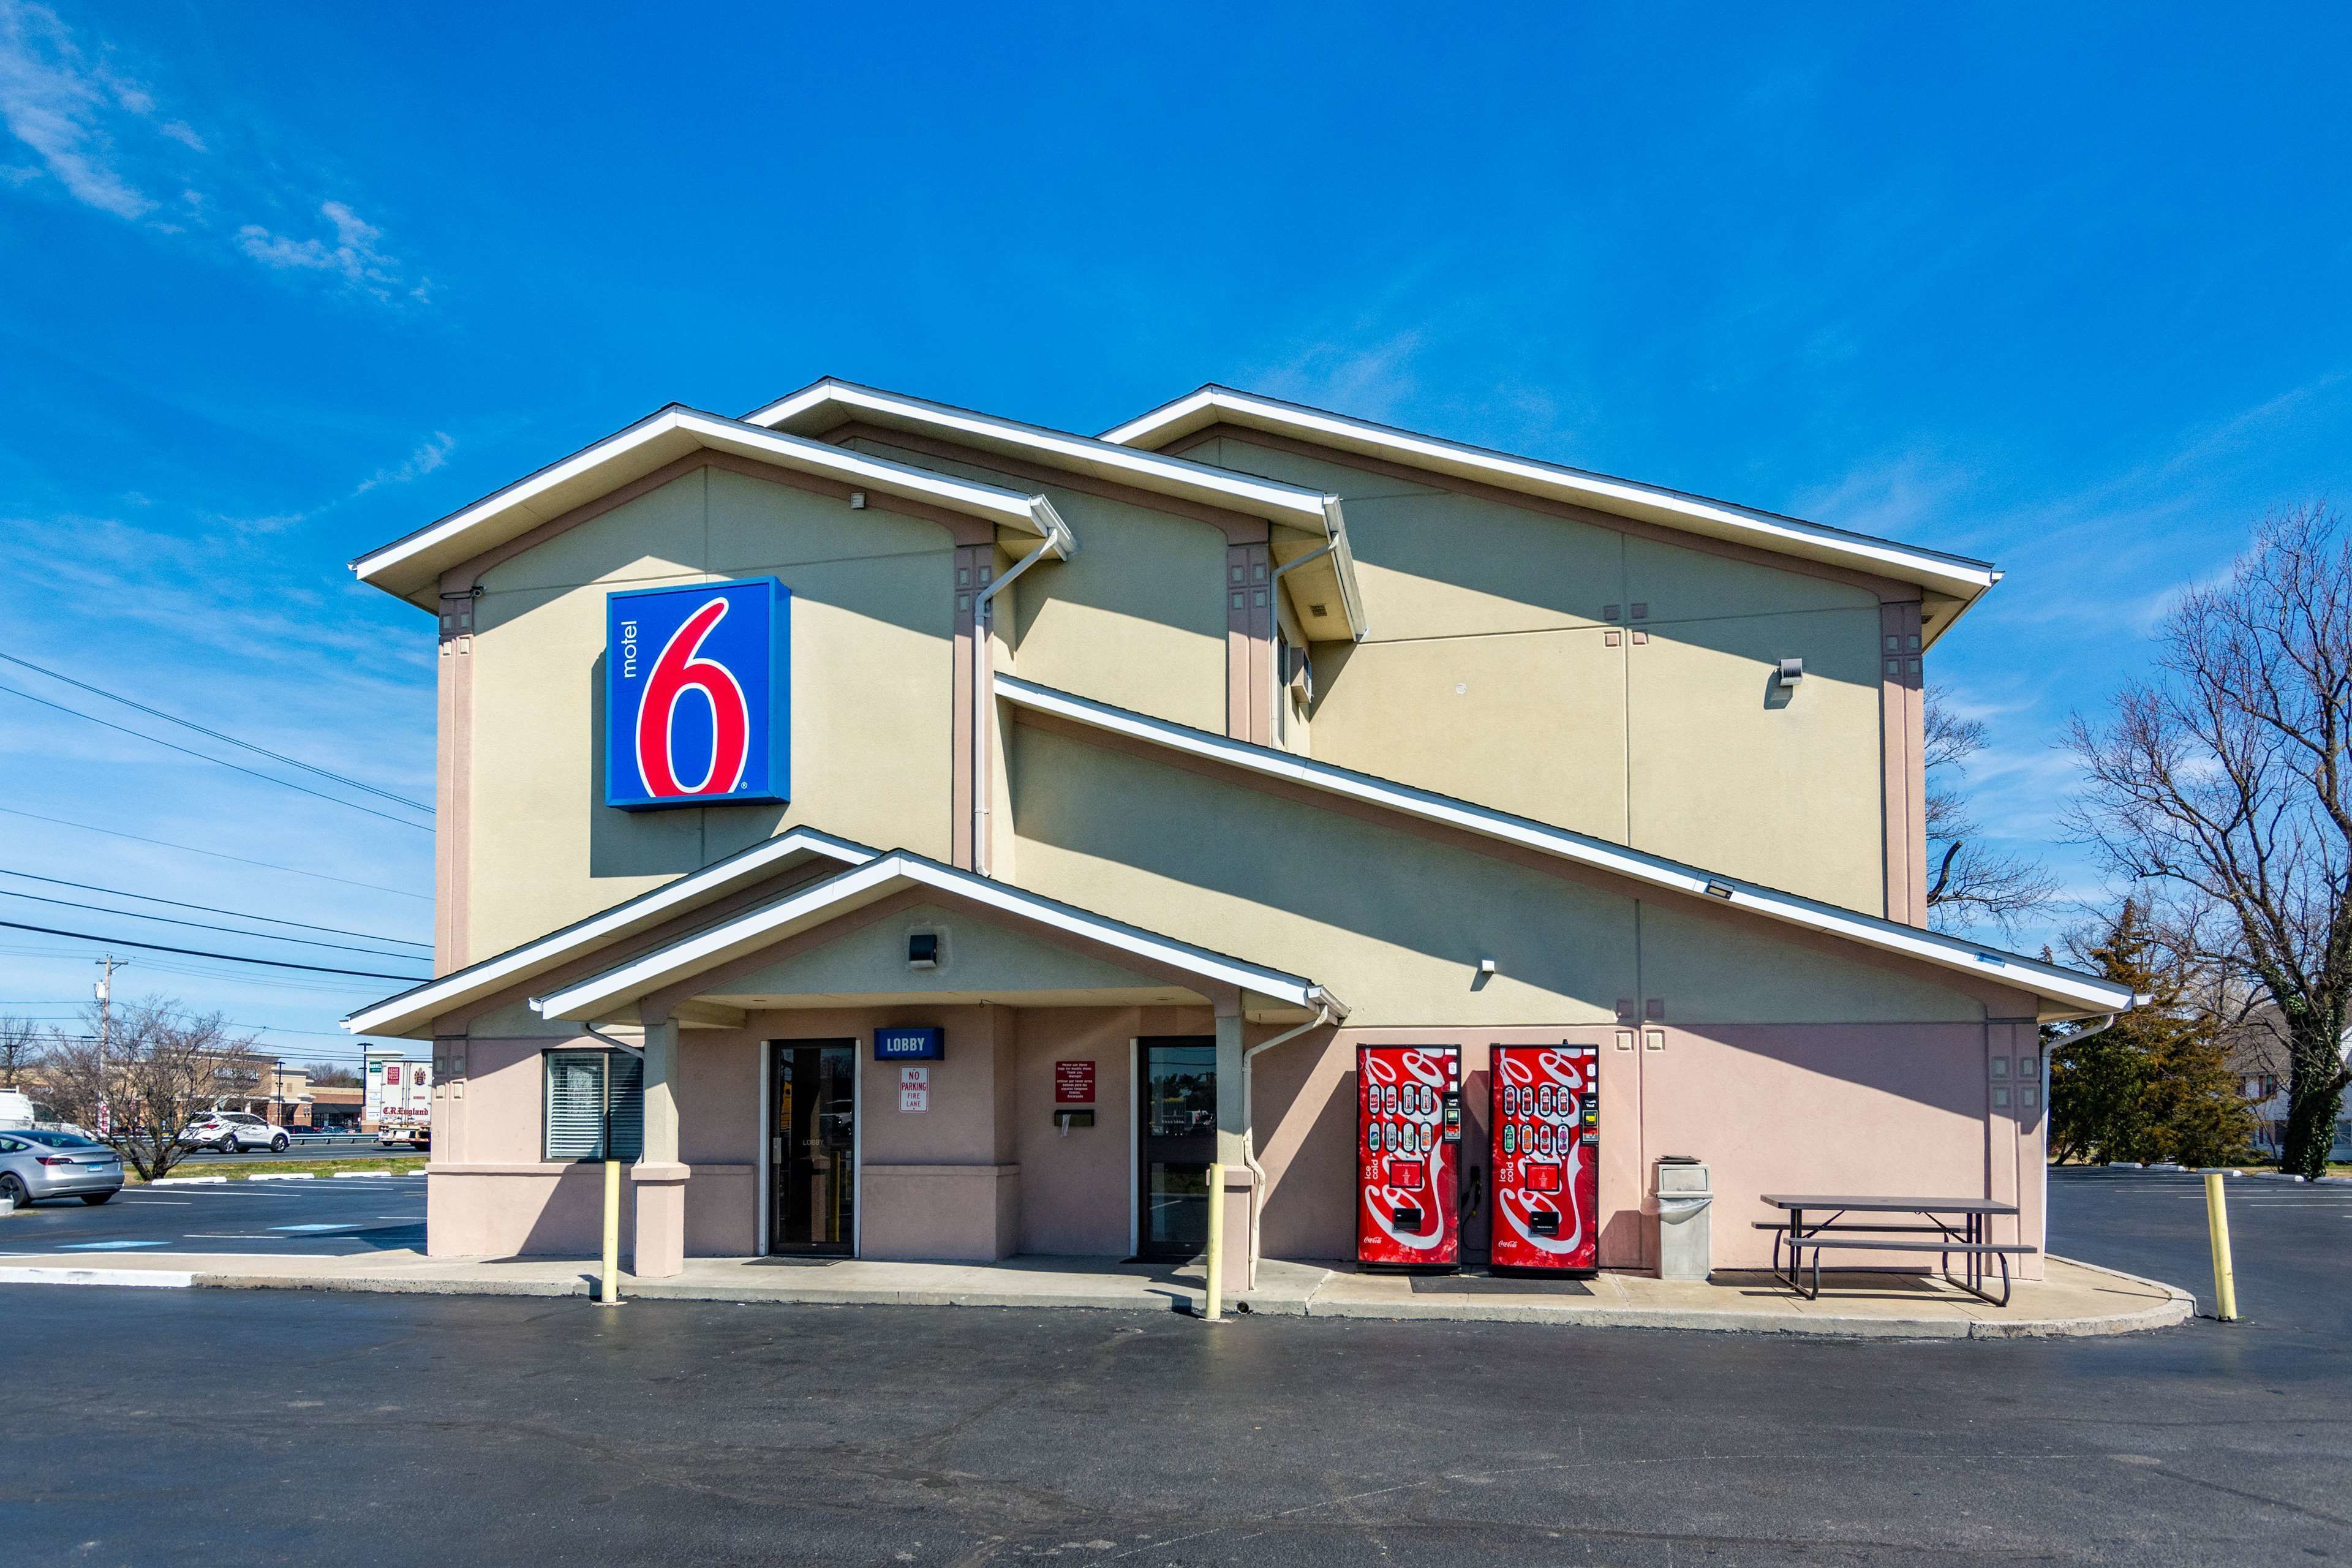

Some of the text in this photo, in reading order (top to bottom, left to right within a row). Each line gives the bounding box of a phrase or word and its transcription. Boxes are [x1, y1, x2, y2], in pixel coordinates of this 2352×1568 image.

[621, 620, 637, 677] motel
[635, 597, 750, 797] 6
[887, 1038, 925, 1052] LOBBY
[909, 1071, 919, 1080] NO
[902, 1082, 926, 1091] PARKING
